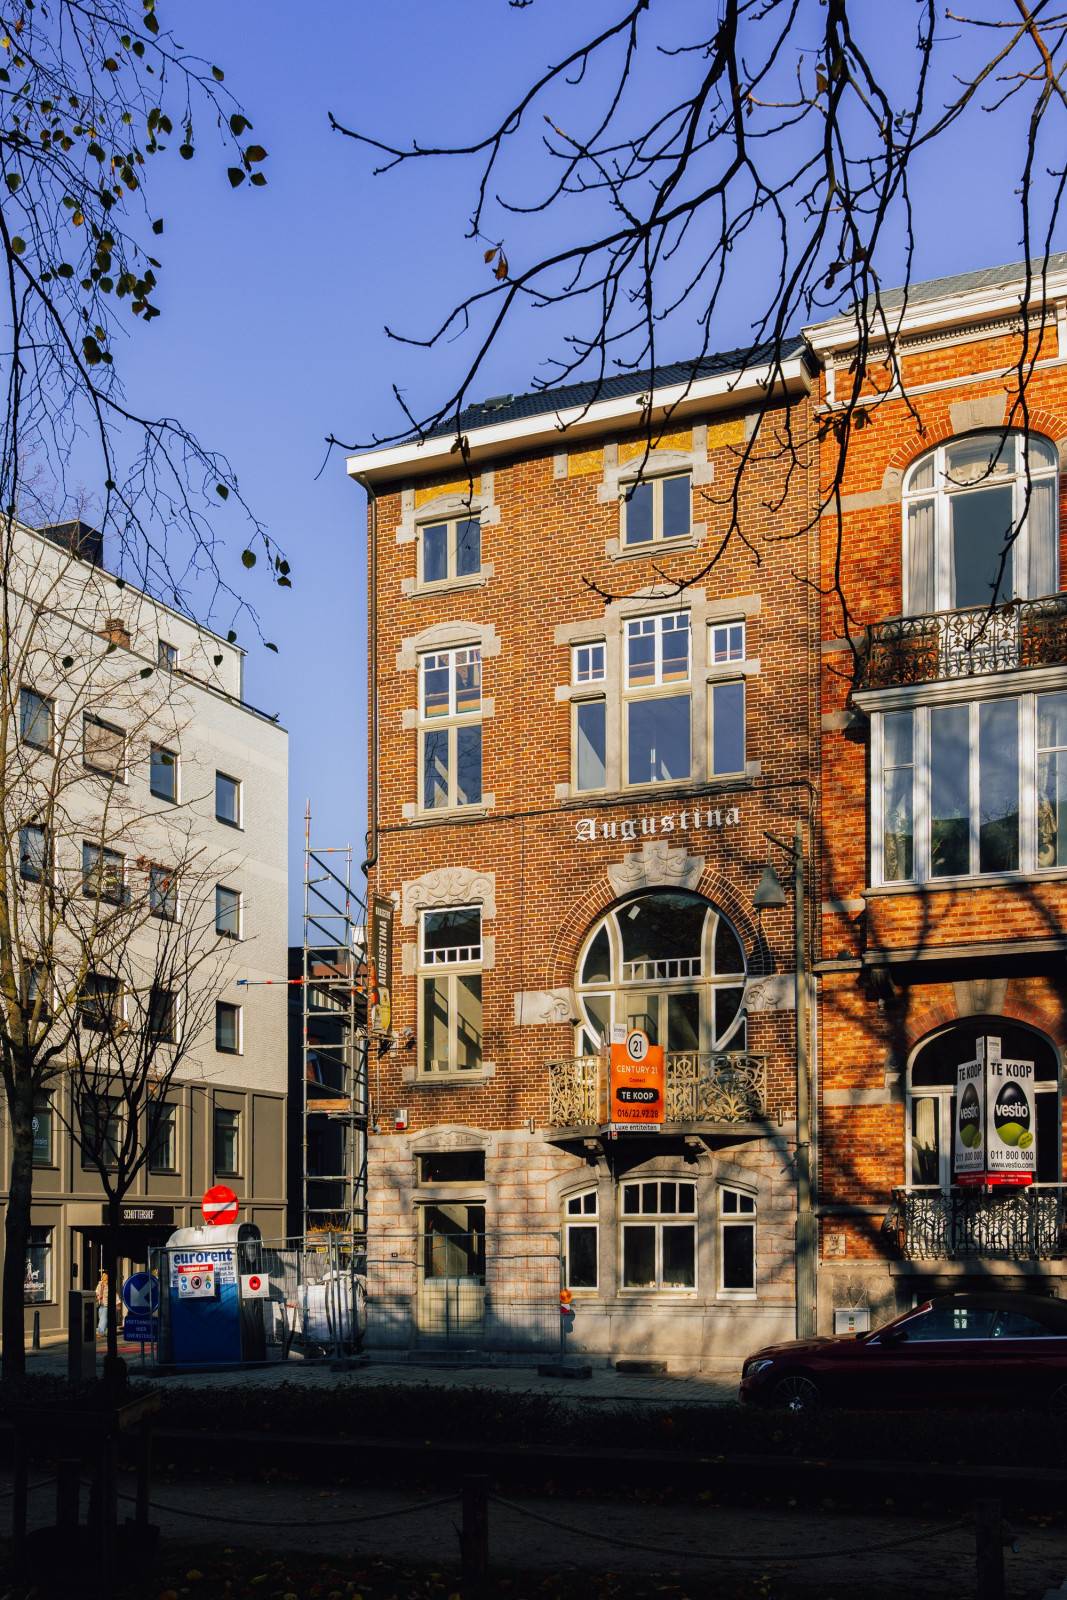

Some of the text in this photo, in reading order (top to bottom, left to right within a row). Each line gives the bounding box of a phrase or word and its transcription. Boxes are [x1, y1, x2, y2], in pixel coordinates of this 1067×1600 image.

[575, 807, 741, 843] Augustina
[378, 919, 388, 986] AUGUSTINA
[616, 1064, 658, 1074] CENTURY 21
[958, 1063, 982, 1081] TE KOOP
[990, 1062, 1033, 1078] TE KOOP
[621, 1091, 655, 1101] TE KOOP
[617, 1108, 659, 1119] 016/22.92.28
[960, 1102, 979, 1120] vestio
[995, 1101, 1028, 1118] vestio
[614, 1123, 629, 1132] Luxe
[990, 1150, 1034, 1160] 011 800 000
[990, 1161, 1034, 1169] www.vestio.com
[174, 1249, 232, 1264] eurorent
